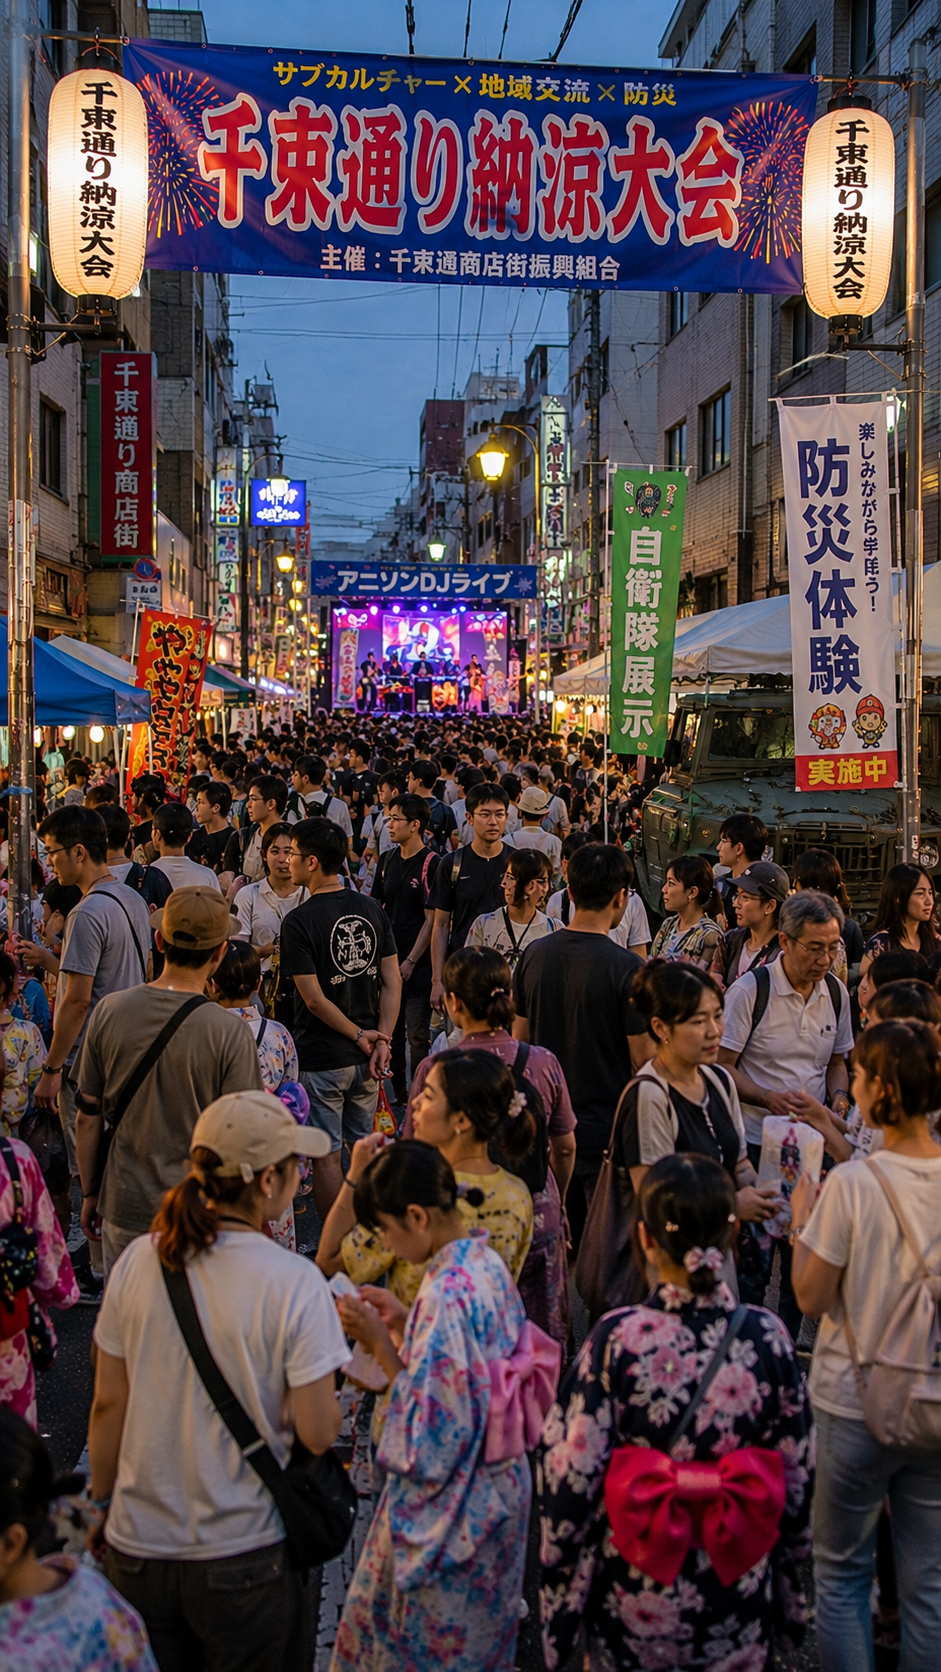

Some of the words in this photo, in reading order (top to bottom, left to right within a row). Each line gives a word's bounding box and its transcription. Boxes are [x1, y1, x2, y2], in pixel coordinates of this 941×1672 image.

[199, 93, 743, 248] 千束通り納涼大会
[337, 570, 514, 594] アニソンDJライブ
[620, 526, 663, 738] 自衛隊展示
[797, 437, 863, 696] 防災体験
[808, 755, 887, 785] 実施中
